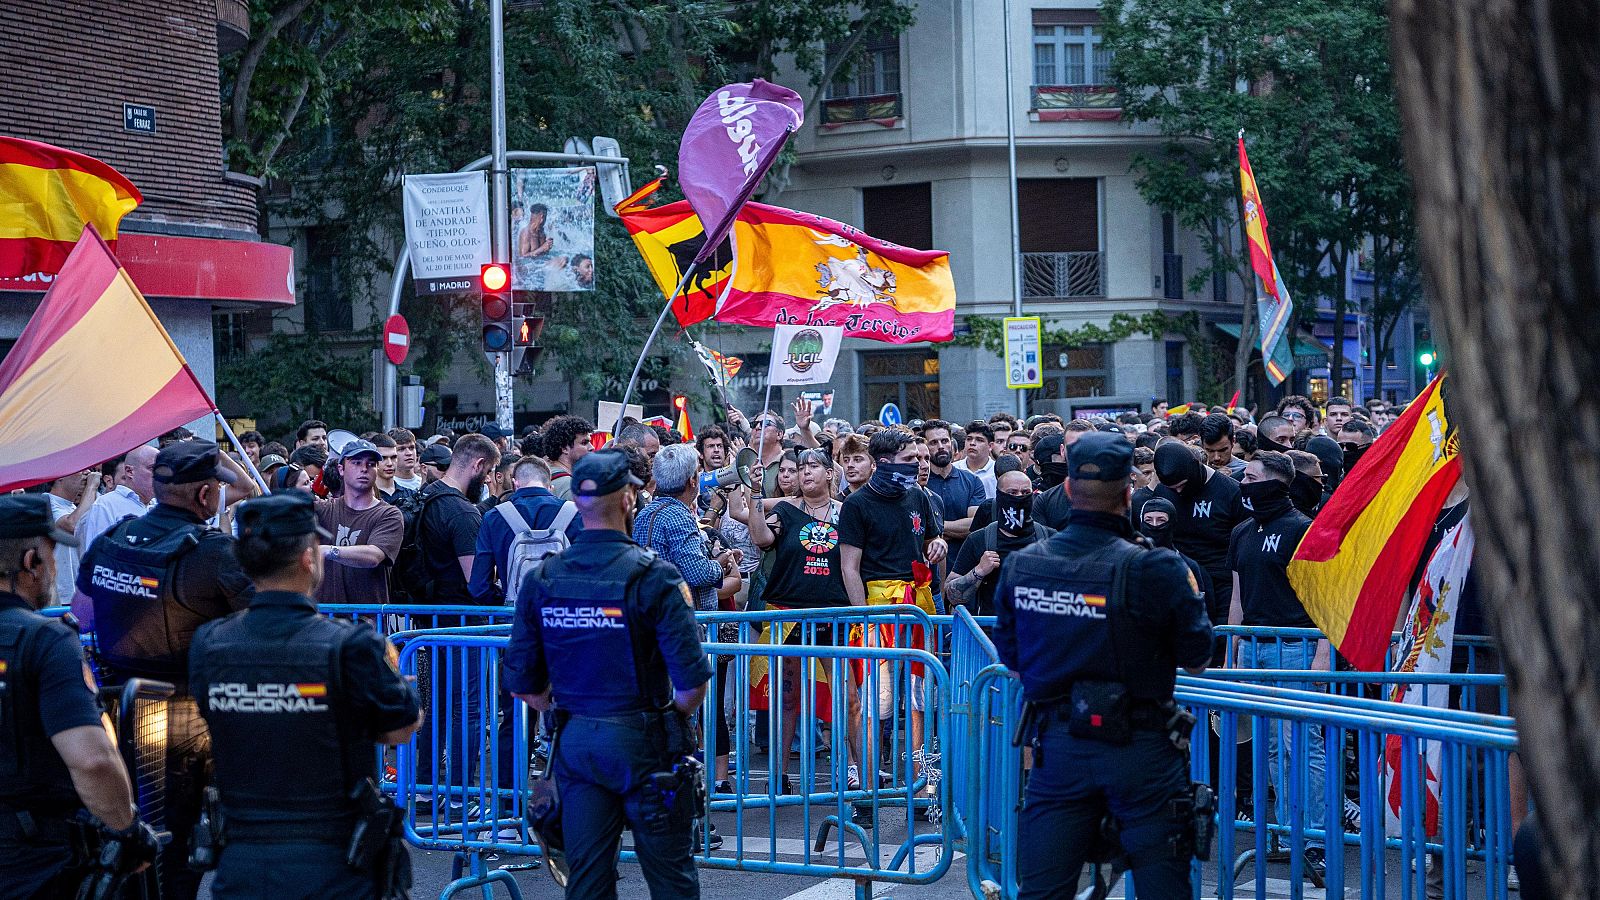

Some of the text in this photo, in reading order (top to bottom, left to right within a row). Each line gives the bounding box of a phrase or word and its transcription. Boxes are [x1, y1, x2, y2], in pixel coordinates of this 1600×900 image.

[134, 118, 151, 129] FERRAZ
[422, 185, 469, 194] CONDEDUQUE
[421, 205, 471, 217] JONATHAS
[415, 216, 478, 228] DE ANDRADE
[414, 239, 449, 249] SUEÑO,
[436, 254, 443, 262] 30
[444, 254, 452, 262] DE
[454, 253, 474, 261] MAYO
[425, 264, 434, 272] AL
[453, 262, 473, 271] JULIO
[439, 281, 471, 290] MADRID
[845, 312, 922, 339] Tercios
[783, 352, 823, 365] JUCIL
[436, 415, 465, 430] Bistro
[93, 564, 143, 586] POLICIA
[803, 565, 831, 576] 2030
[91, 575, 158, 598] NACIONAL
[1014, 585, 1087, 605] POLICIA
[541, 606, 607, 618] POLICIA
[1014, 597, 1107, 619] NACIONAL
[542, 617, 625, 629] NACIONAL
[208, 682, 301, 698] POLICIA
[208, 697, 329, 712] NACIONAL
